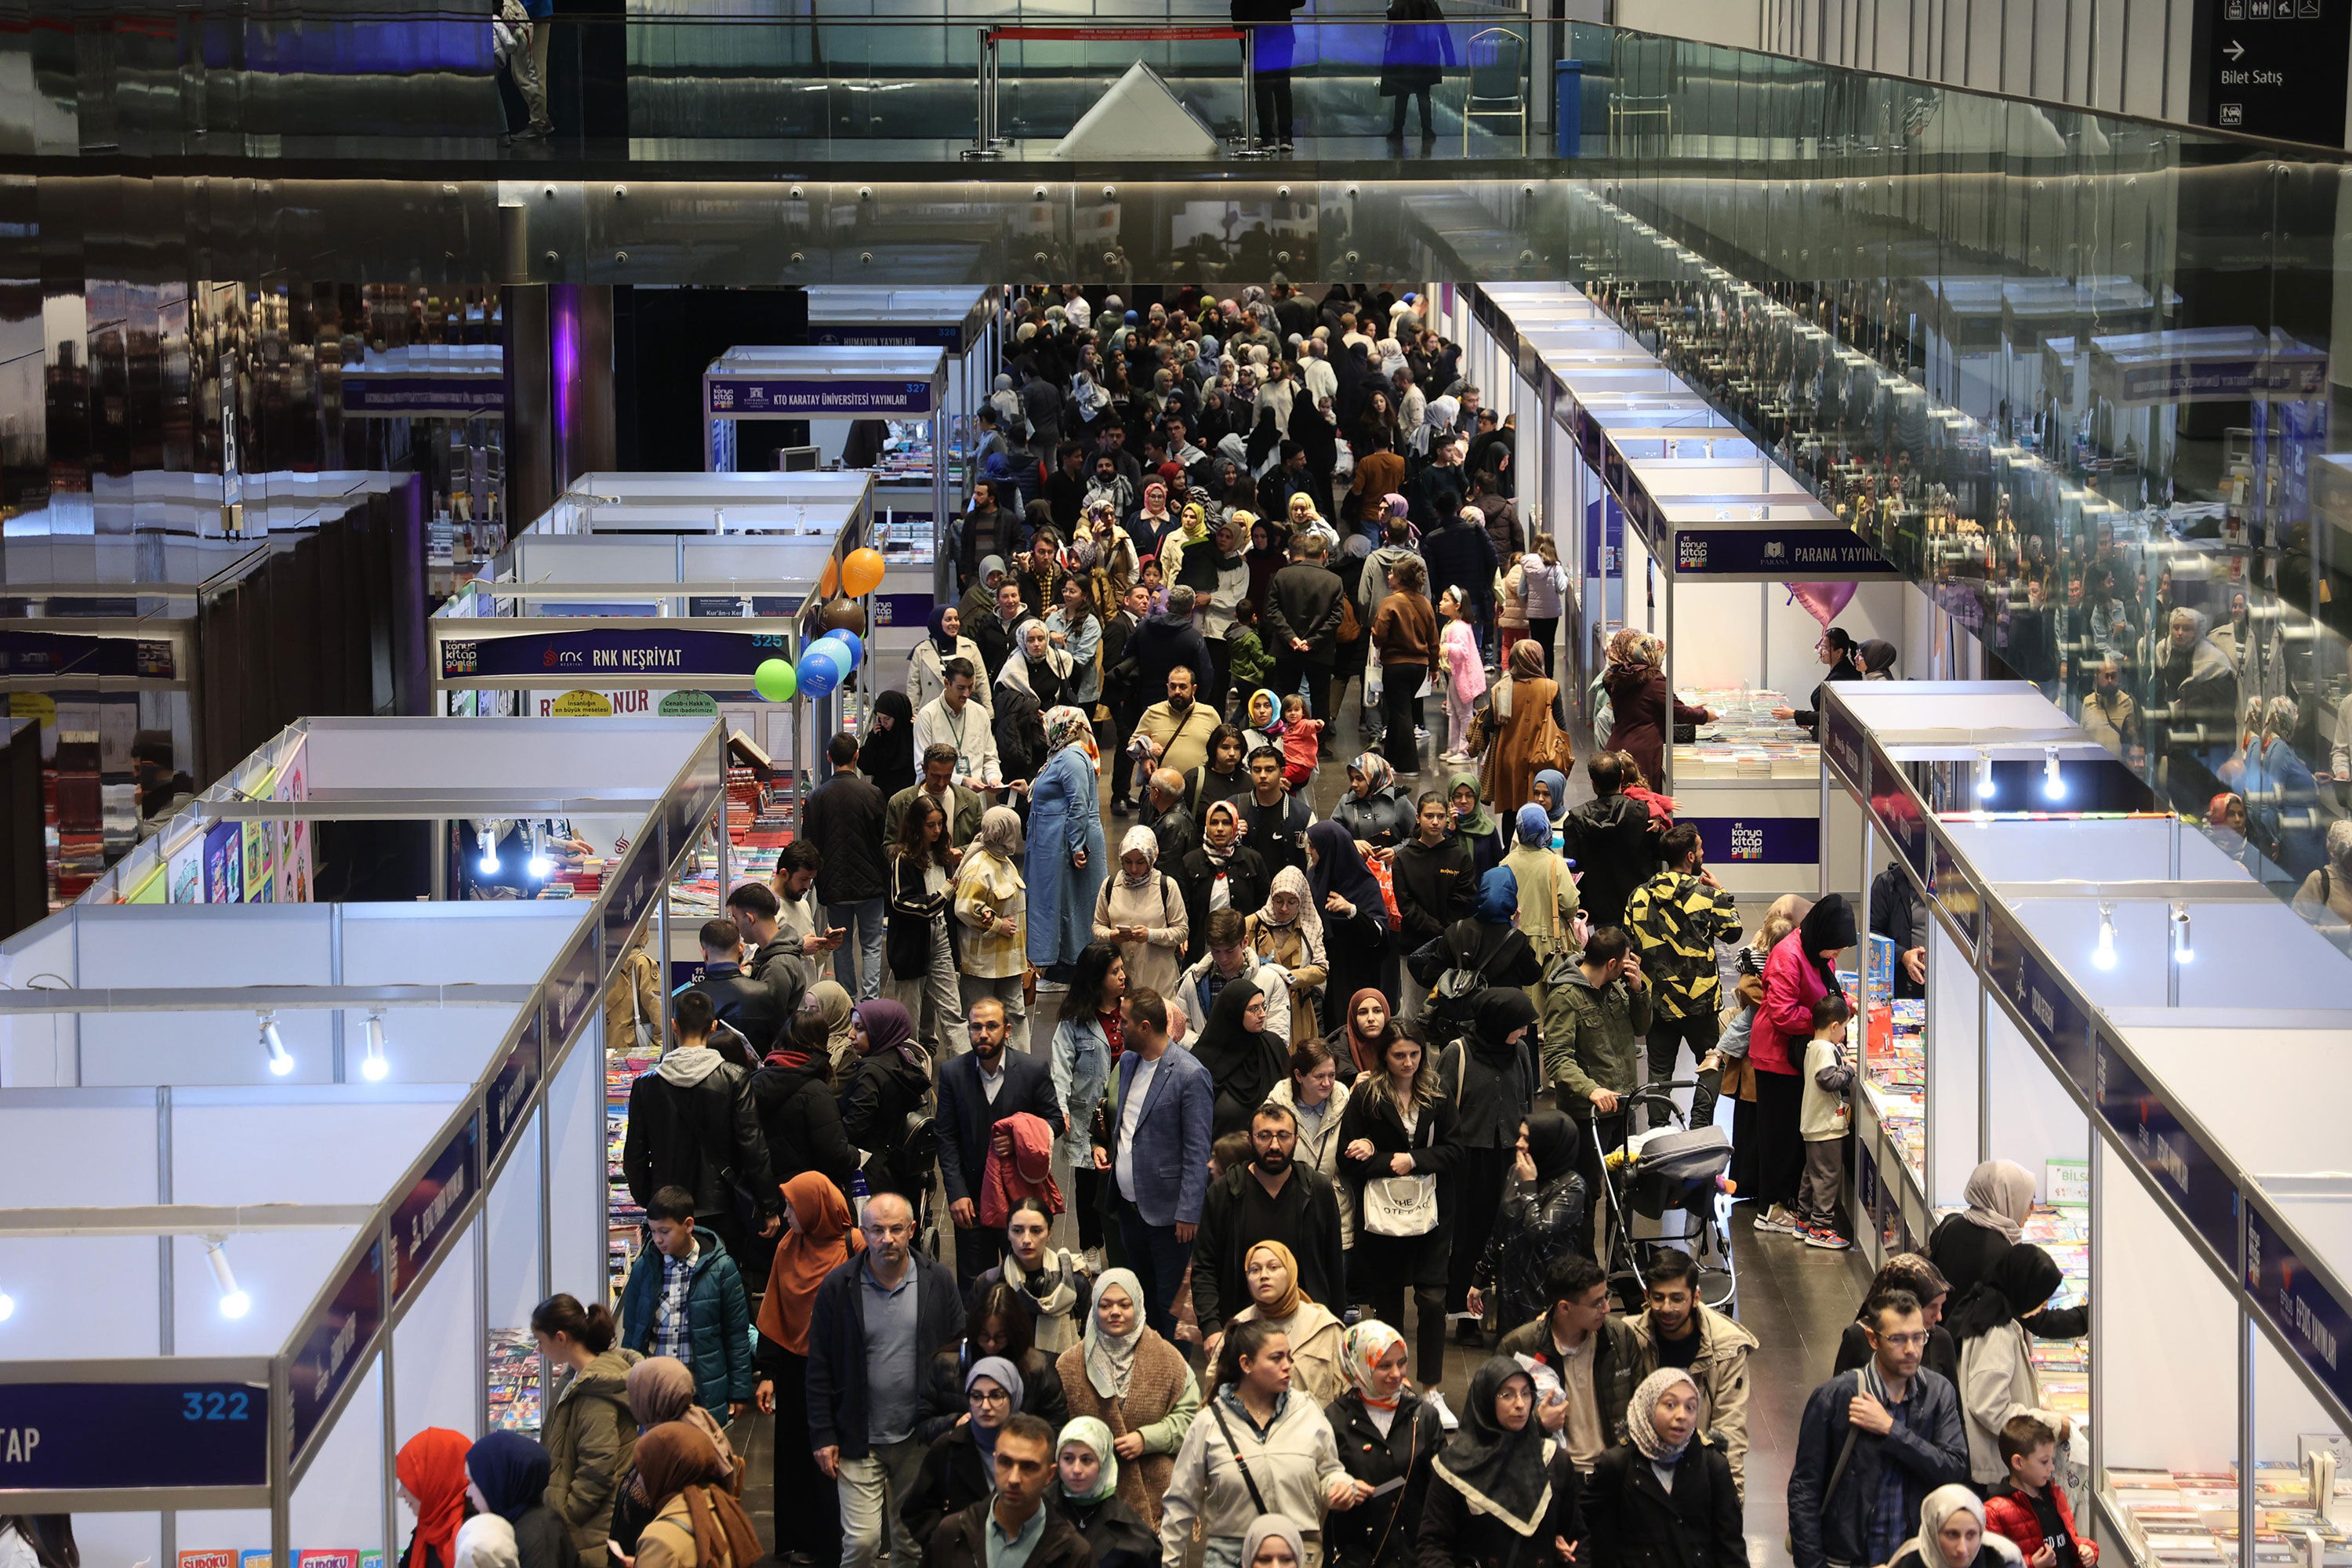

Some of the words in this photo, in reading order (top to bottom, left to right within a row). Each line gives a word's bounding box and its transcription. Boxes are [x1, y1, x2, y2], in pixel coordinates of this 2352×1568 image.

[2221, 70, 2249, 84] Bilet
[2252, 70, 2283, 86] Satış
[906, 383, 926, 393] 327
[773, 394, 787, 405] KTO
[789, 394, 820, 405] KARATAY
[822, 392, 869, 405] ÜNİVERSİTESİ
[870, 394, 907, 405] YAYINLARI
[1680, 540, 1708, 550] konya
[1680, 547, 1708, 558] kitap
[1795, 547, 1838, 562] PARANA
[752, 633, 782, 648] 325
[446, 642, 477, 652] konya
[446, 650, 477, 661] kitap
[593, 650, 619, 666] RNK
[622, 646, 681, 670] NEŞRİYAT
[446, 659, 477, 669] günleri
[613, 690, 648, 714] NUR
[1731, 827, 1762, 838] konya
[1731, 836, 1762, 848] kitap
[1731, 845, 1762, 855] günleri
[2296, 1294, 2311, 1341] EFSUS
[2312, 1312, 2336, 1371] YAYINLARI
[183, 1392, 249, 1421] 322
